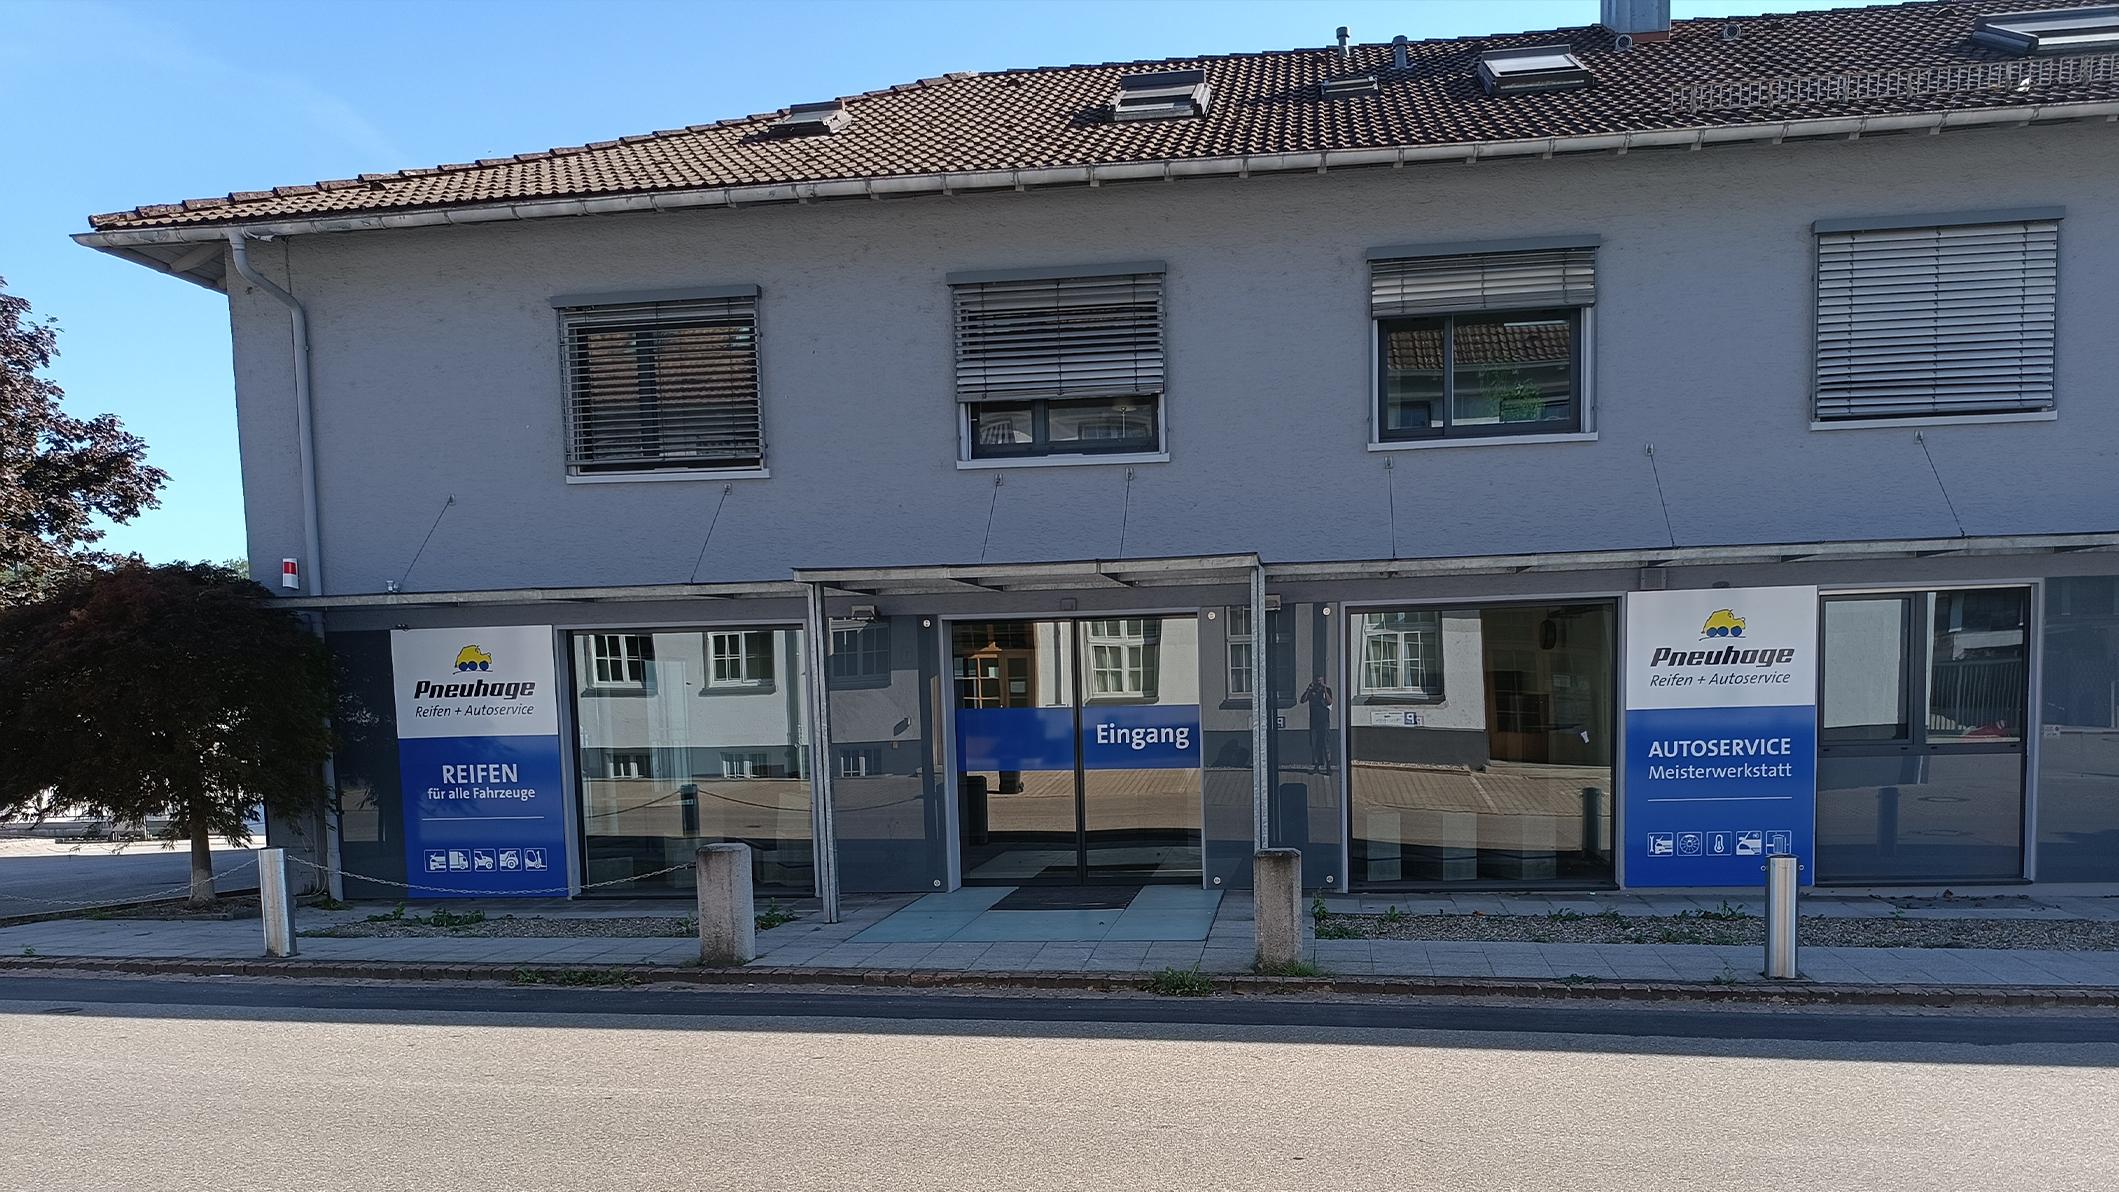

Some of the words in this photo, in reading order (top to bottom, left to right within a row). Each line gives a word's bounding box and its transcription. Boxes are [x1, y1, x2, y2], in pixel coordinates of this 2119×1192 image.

[1650, 646, 1795, 668] Pneuhage
[1650, 673, 1693, 687] Reifen
[1708, 671, 1791, 685] Autoservice
[414, 679, 536, 700] Pneuhage
[415, 705, 451, 718] Reifen
[464, 704, 534, 716] Autoservice
[1096, 723, 1190, 750] Eingang
[1648, 738, 1791, 758] AUTOSERVICE
[442, 764, 518, 784] REIFEN
[1648, 763, 1793, 780] Meisterwerkstatt
[427, 788, 446, 800] für
[448, 787, 470, 799] alle
[473, 787, 536, 801] Fahrzeuge
